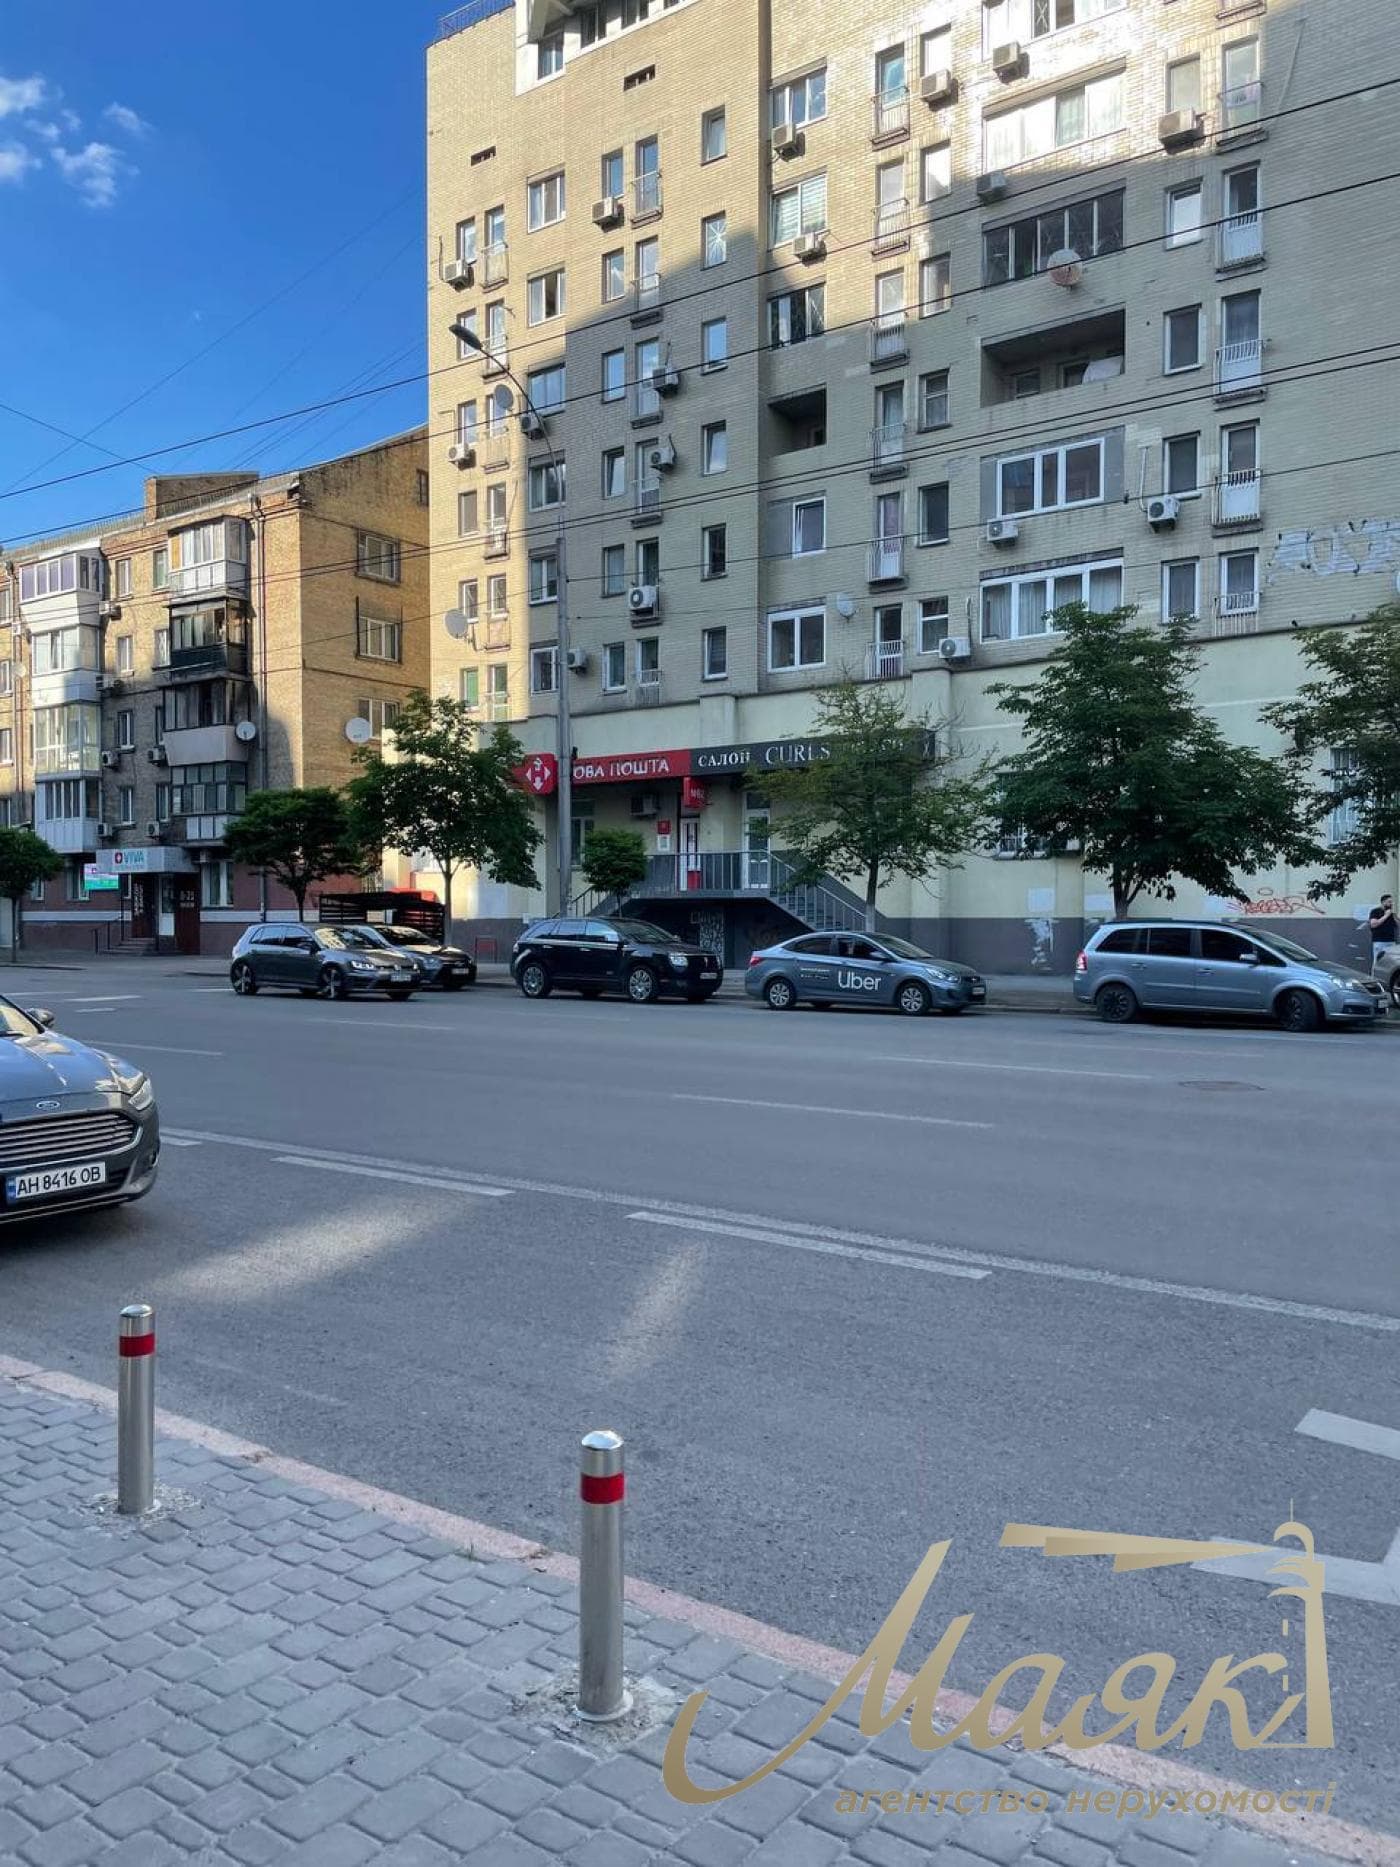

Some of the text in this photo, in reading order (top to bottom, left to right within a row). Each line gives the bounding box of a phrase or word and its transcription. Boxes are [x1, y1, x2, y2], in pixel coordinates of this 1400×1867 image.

[572, 759, 670, 780] ОВА ПОШТА
[837, 970, 882, 991] Uber
[17, 1166, 101, 1195] AH 8416 OB
